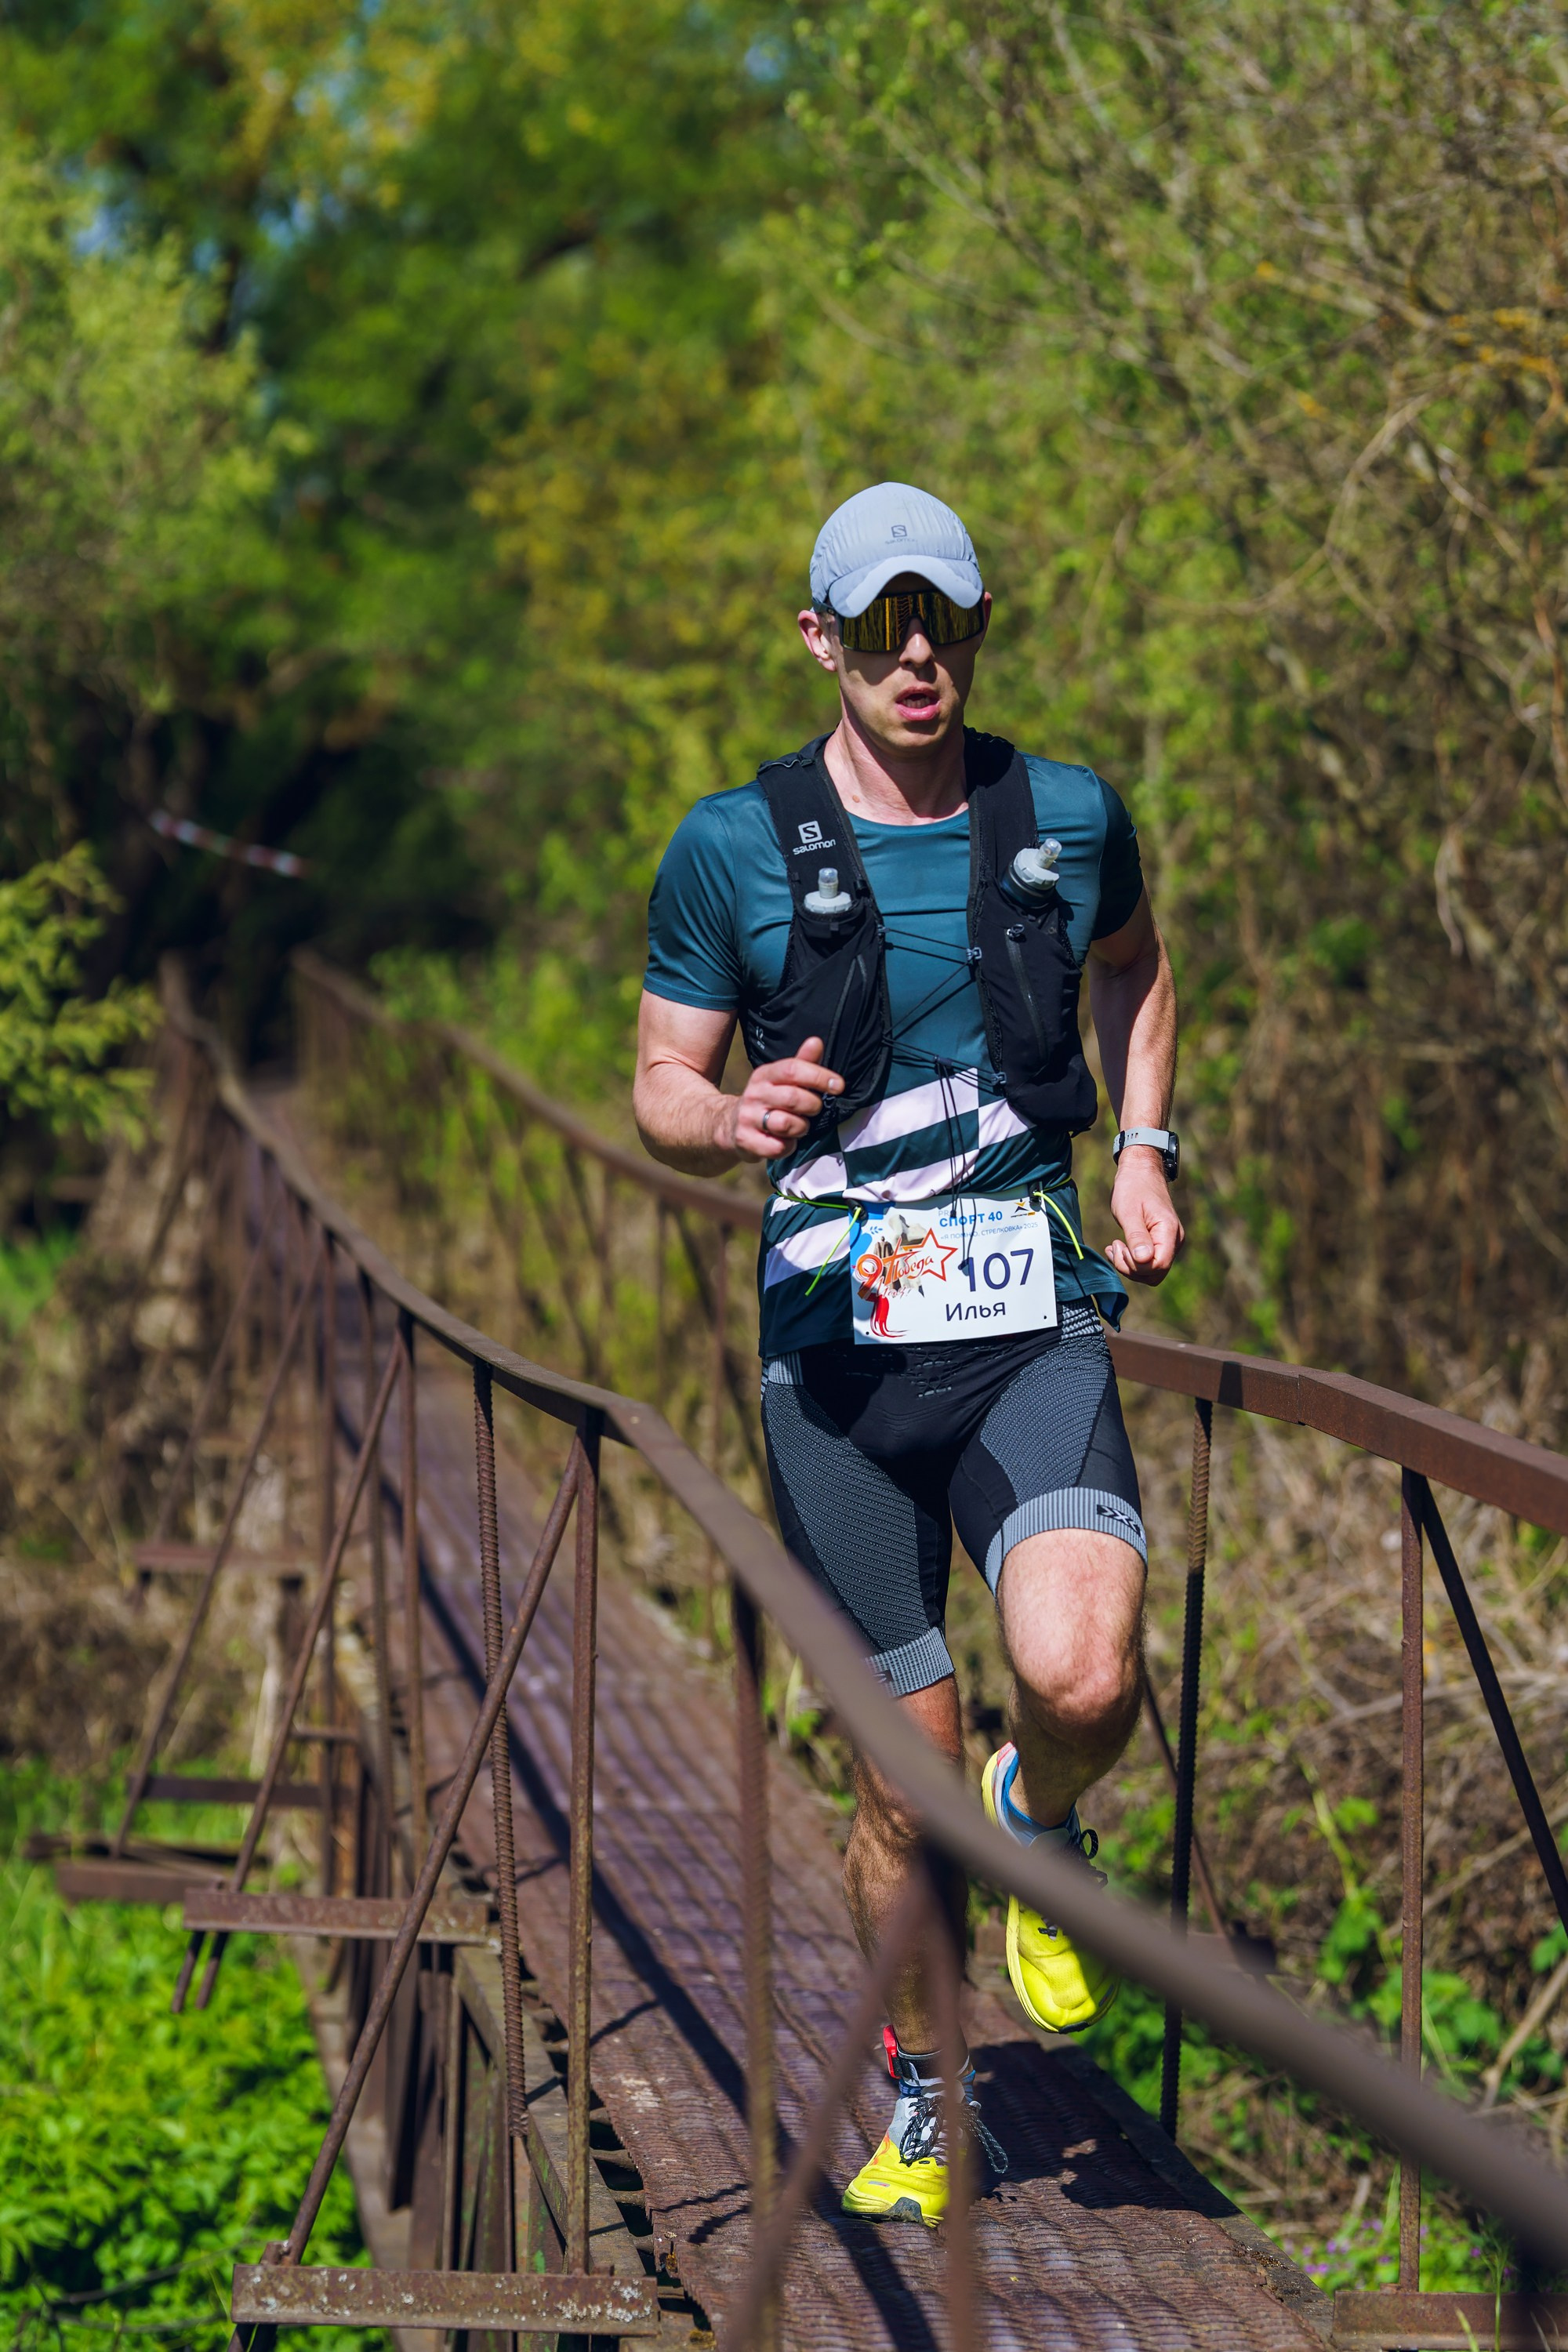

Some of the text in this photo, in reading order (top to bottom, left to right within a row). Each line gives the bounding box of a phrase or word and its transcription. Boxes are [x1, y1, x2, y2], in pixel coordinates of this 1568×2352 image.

[801, 823, 819, 841] S
[793, 839, 836, 855] salomon
[939, 1213, 985, 1227] СПОРТ
[988, 1210, 1003, 1221] 40
[982, 1225, 1022, 1236] СТРЕЛКОВКА»
[963, 1248, 1033, 1292] 107
[946, 1301, 1006, 1322] Илья
